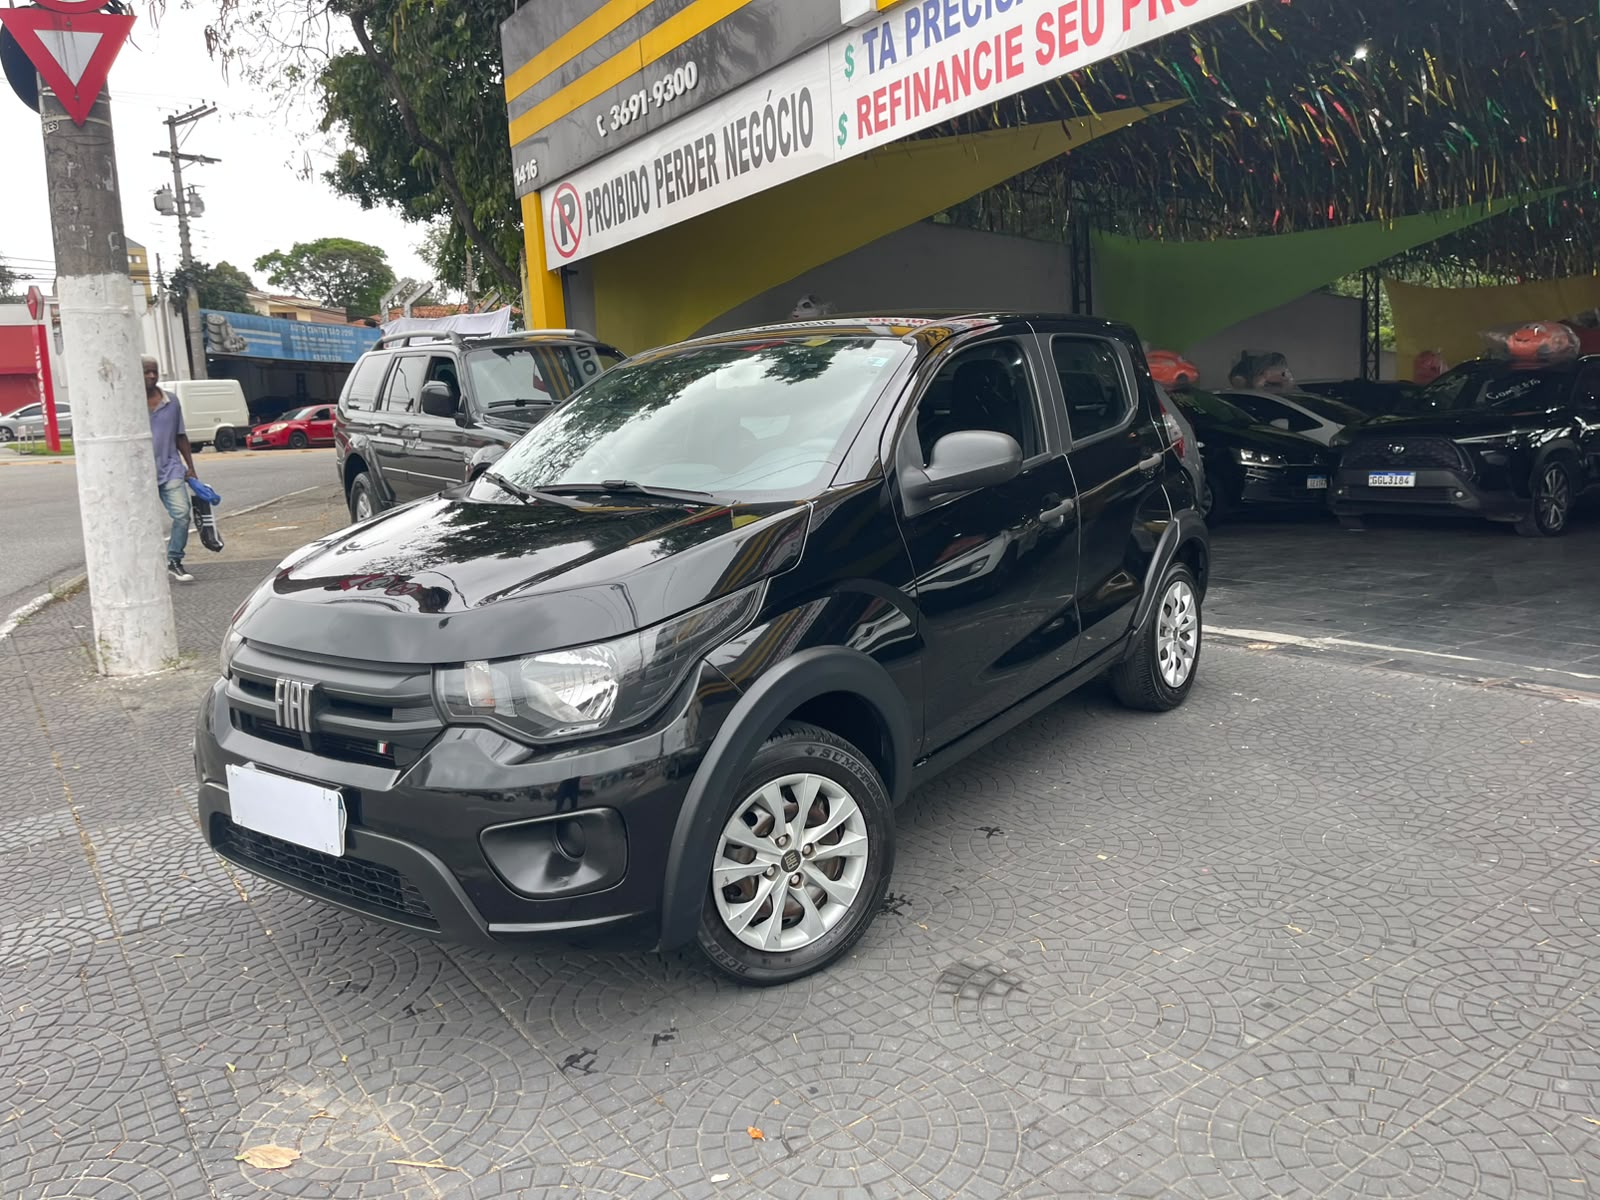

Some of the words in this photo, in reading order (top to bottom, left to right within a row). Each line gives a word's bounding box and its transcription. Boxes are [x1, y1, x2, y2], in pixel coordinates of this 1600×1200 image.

[856, 23, 1025, 141] REFINANCIE
[1035, 0, 1105, 66] SEU
[862, 21, 898, 75] TA
[610, 61, 698, 131] 3691-9300
[513, 158, 538, 186] 1416
[585, 163, 651, 237] PROIBIDO
[653, 132, 719, 209] PERDER
[722, 86, 815, 180] NEGÓCIO
[274, 676, 318, 734] FIAT
